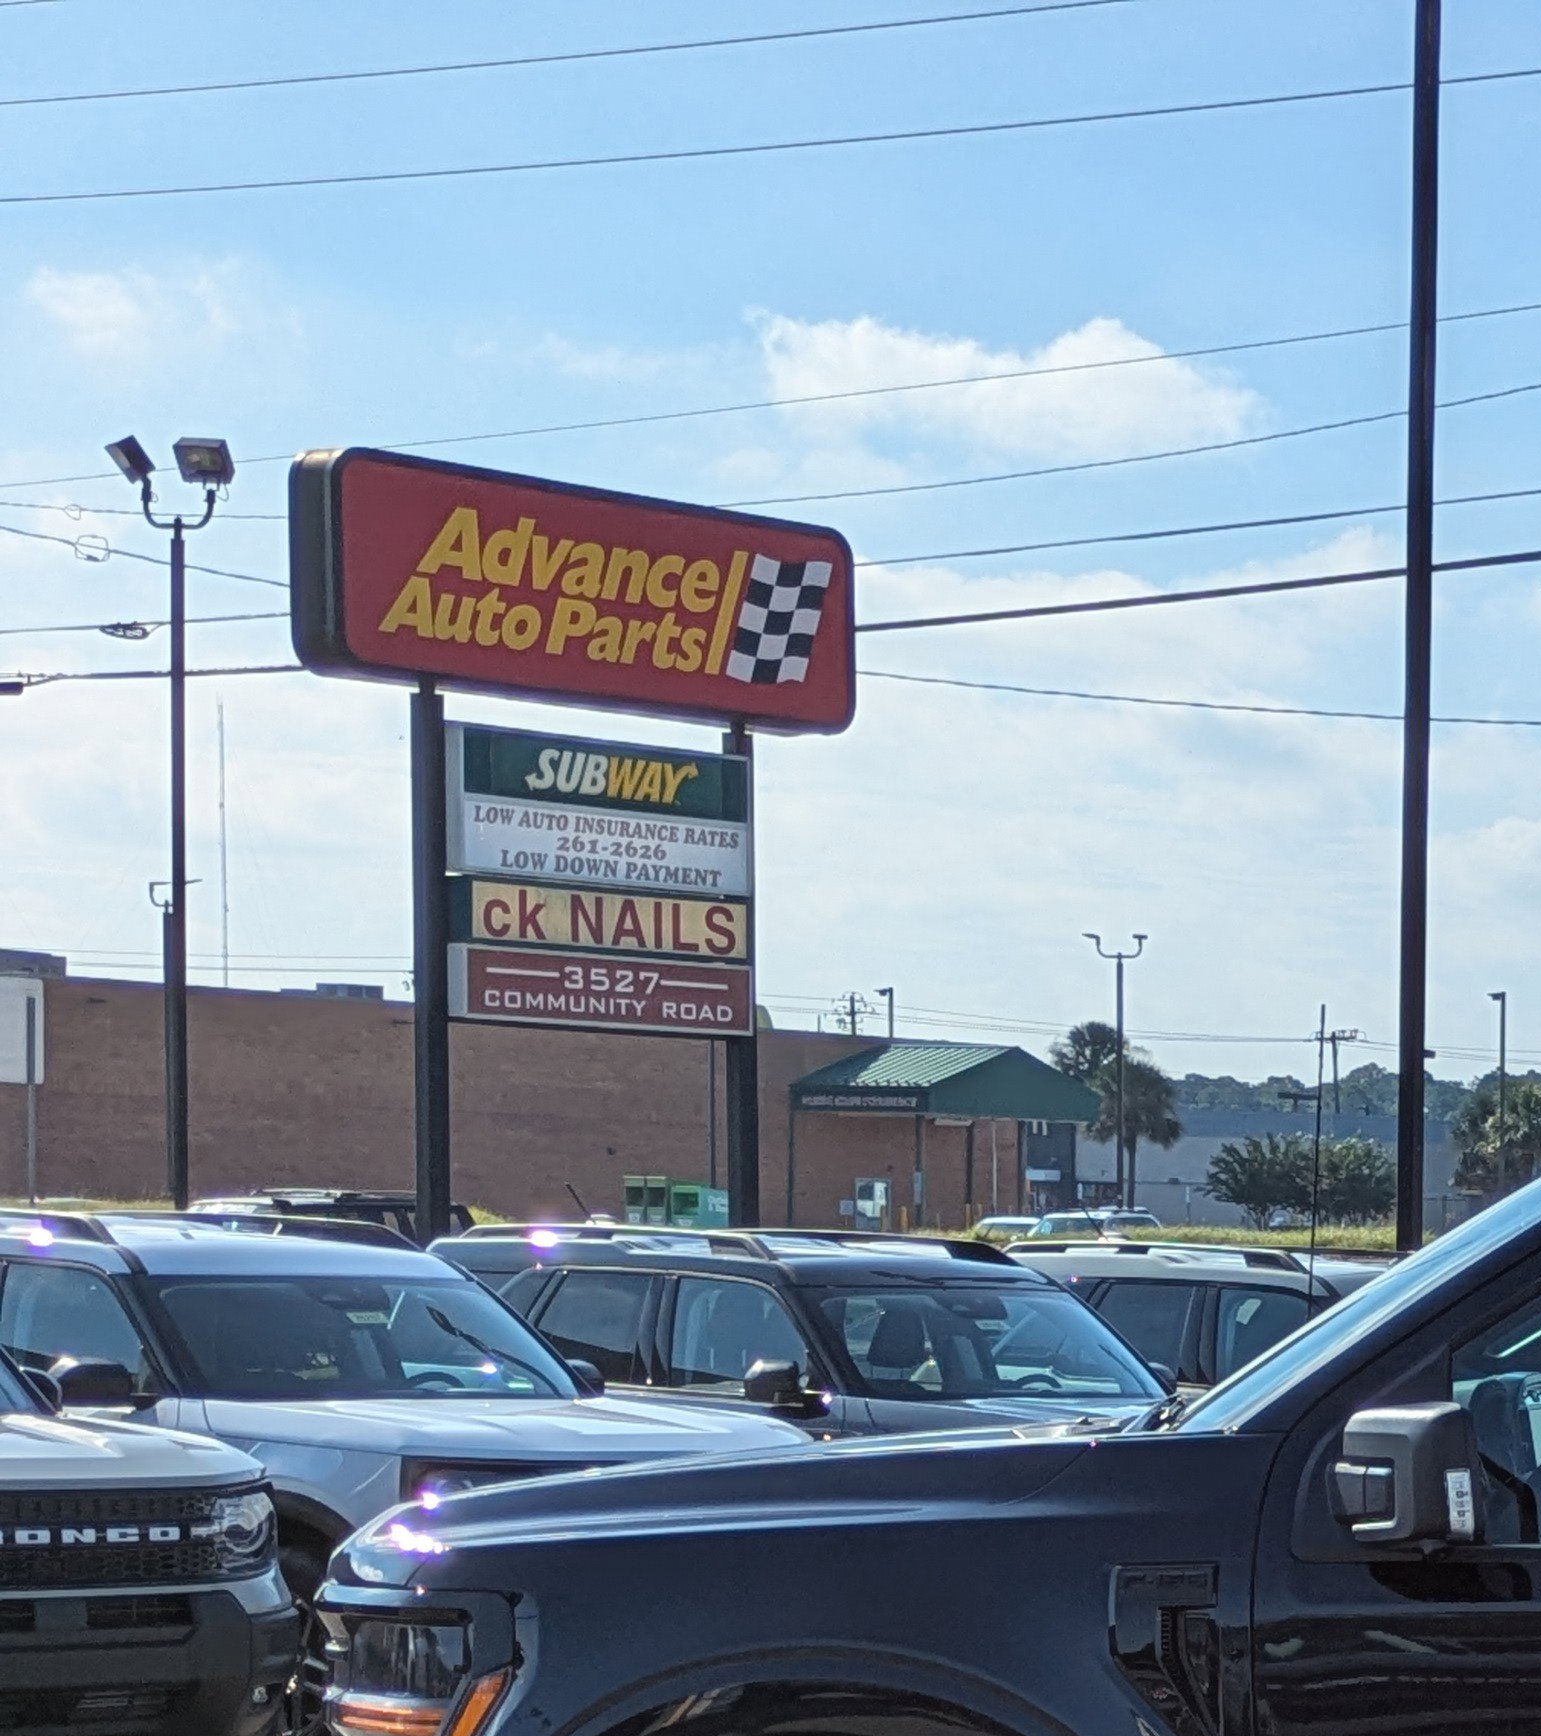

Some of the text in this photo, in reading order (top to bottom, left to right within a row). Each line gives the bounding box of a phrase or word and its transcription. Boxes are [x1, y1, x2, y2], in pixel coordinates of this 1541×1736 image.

[416, 507, 720, 612] Advance
[378, 575, 707, 673] Auto Parts
[524, 749, 699, 804] SUBWAY
[474, 806, 739, 849] LOW AUTO INSURANCE RATES
[500, 850, 722, 888] LOW DOWN PAYMENT
[557, 837, 667, 861] 261-2626
[570, 894, 736, 955] NAILS
[564, 966, 660, 994] 3527
[484, 990, 733, 1022] COMMUNITY ROAD
[0, 1526, 181, 1545] ONCO
